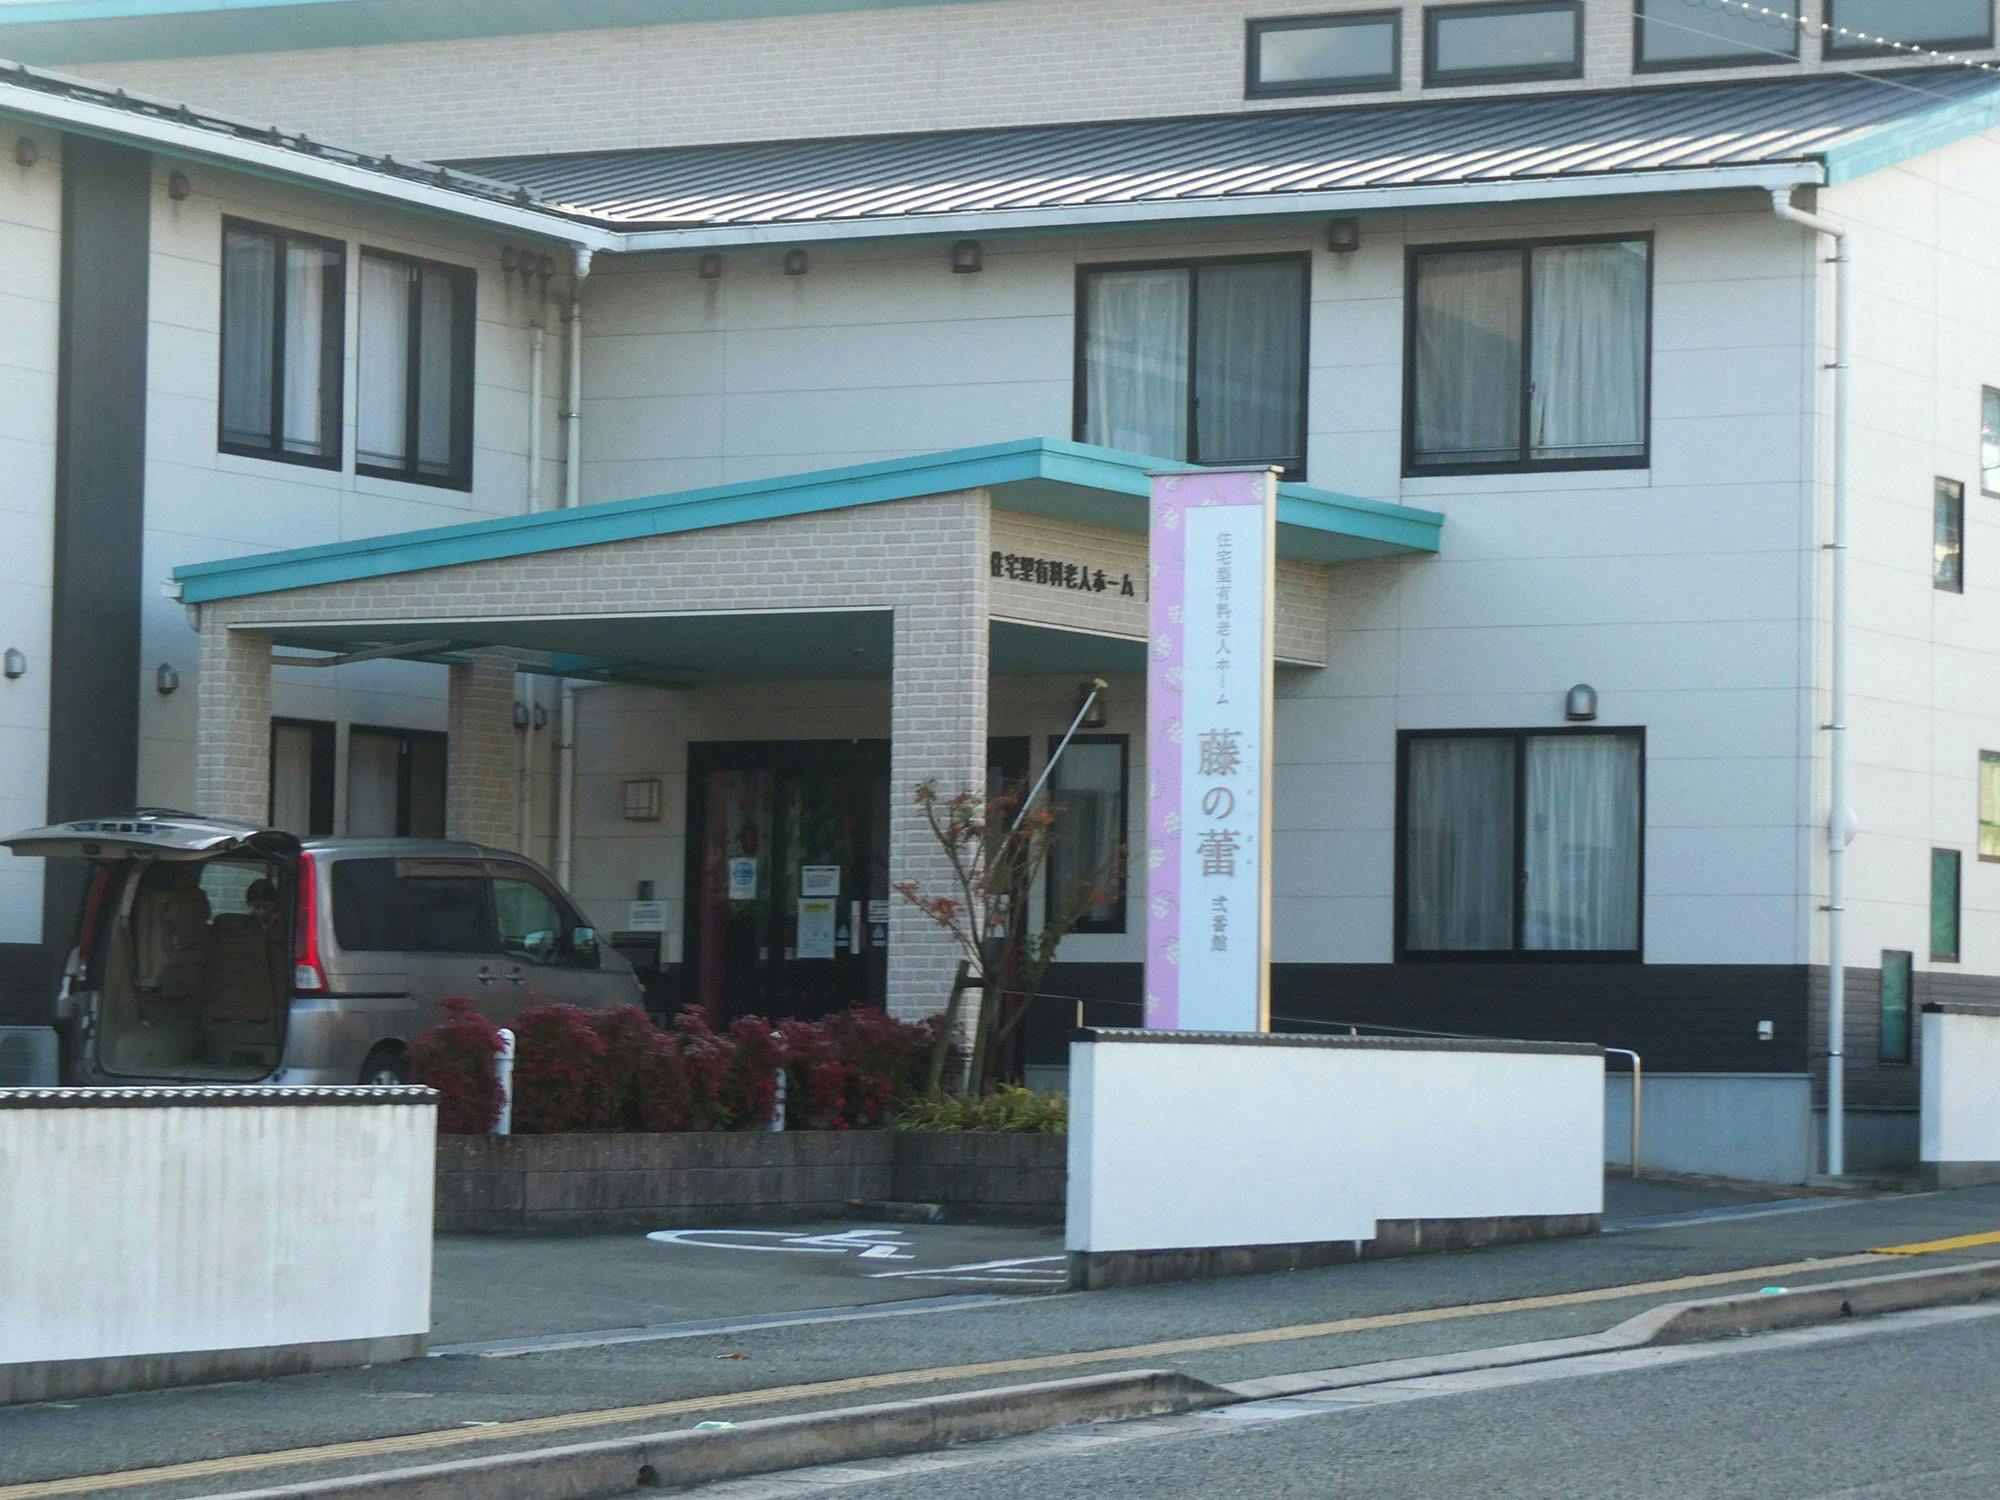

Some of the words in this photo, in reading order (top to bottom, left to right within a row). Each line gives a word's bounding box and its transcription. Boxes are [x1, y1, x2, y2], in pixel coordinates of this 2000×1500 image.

[1215, 530, 1232, 706] 住宅型有料老人ホーム
[1196, 728, 1242, 877] 藤の蕾
